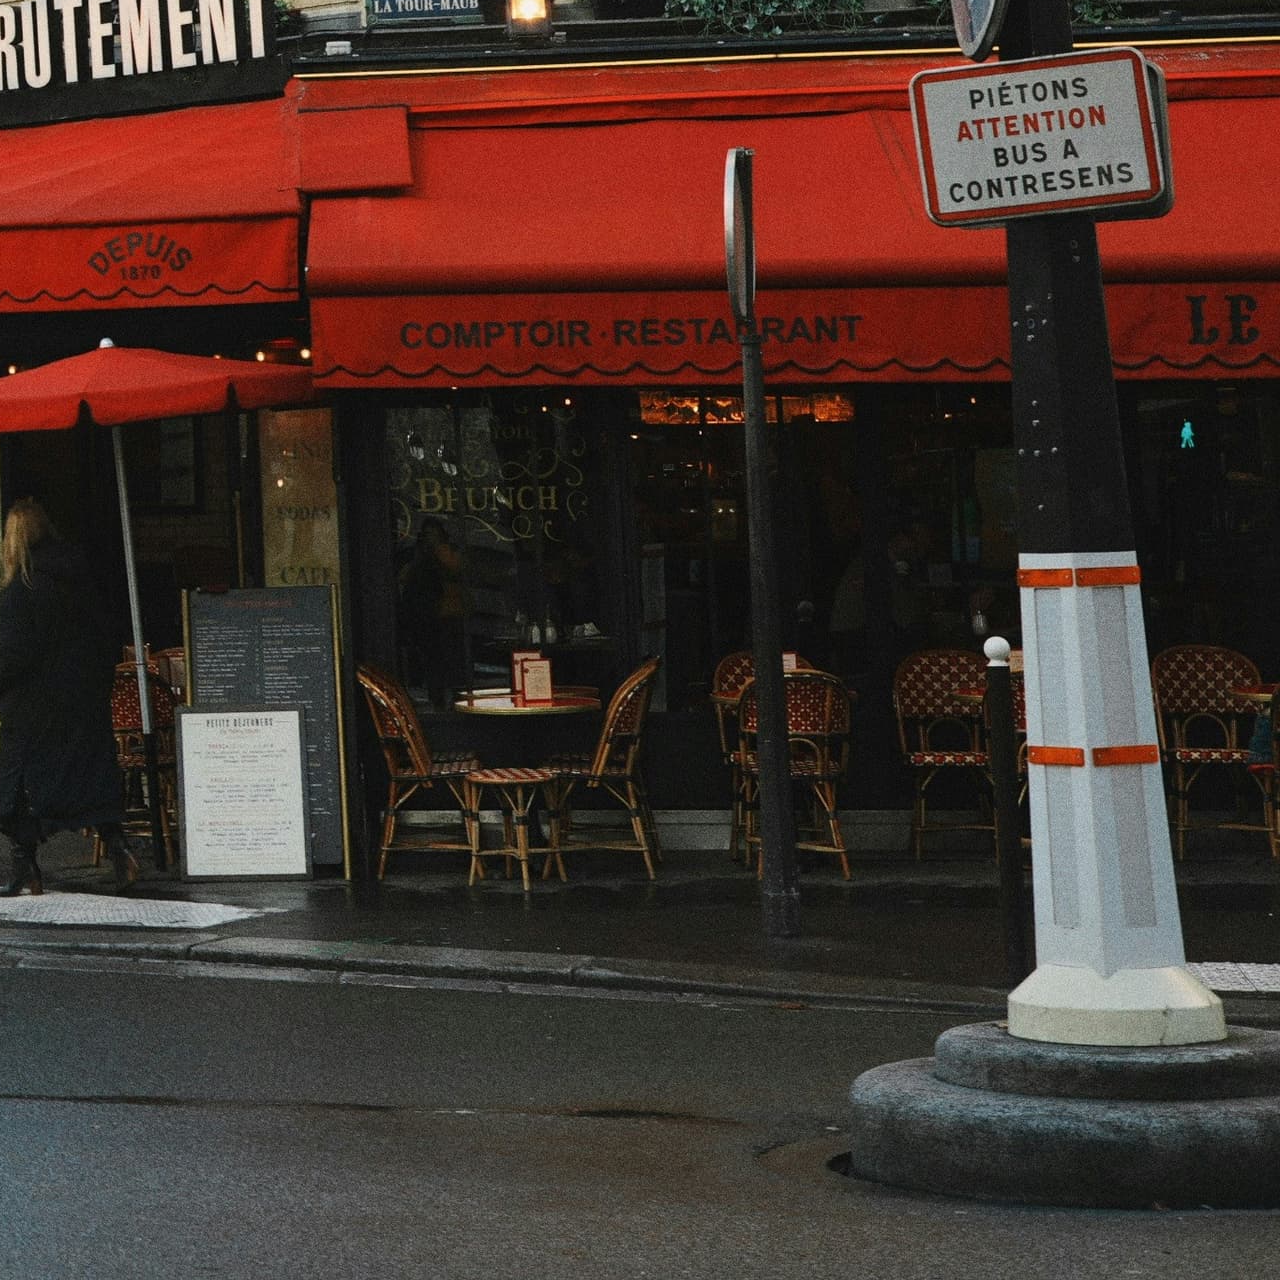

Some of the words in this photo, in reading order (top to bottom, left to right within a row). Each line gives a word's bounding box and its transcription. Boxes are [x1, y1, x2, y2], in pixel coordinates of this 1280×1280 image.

[374, 0, 392, 14] LA
[968, 77, 1089, 110] PIÉTONS
[957, 104, 1108, 142] ATTENTION
[993, 142, 1048, 168] BUS
[1062, 138, 1080, 160] A
[949, 162, 1134, 204] CONTRESENS
[87, 231, 193, 276] DEPUIS
[119, 264, 163, 280] 1870
[399, 319, 592, 350] COMPTOIR
[1184, 293, 1260, 346] LE
